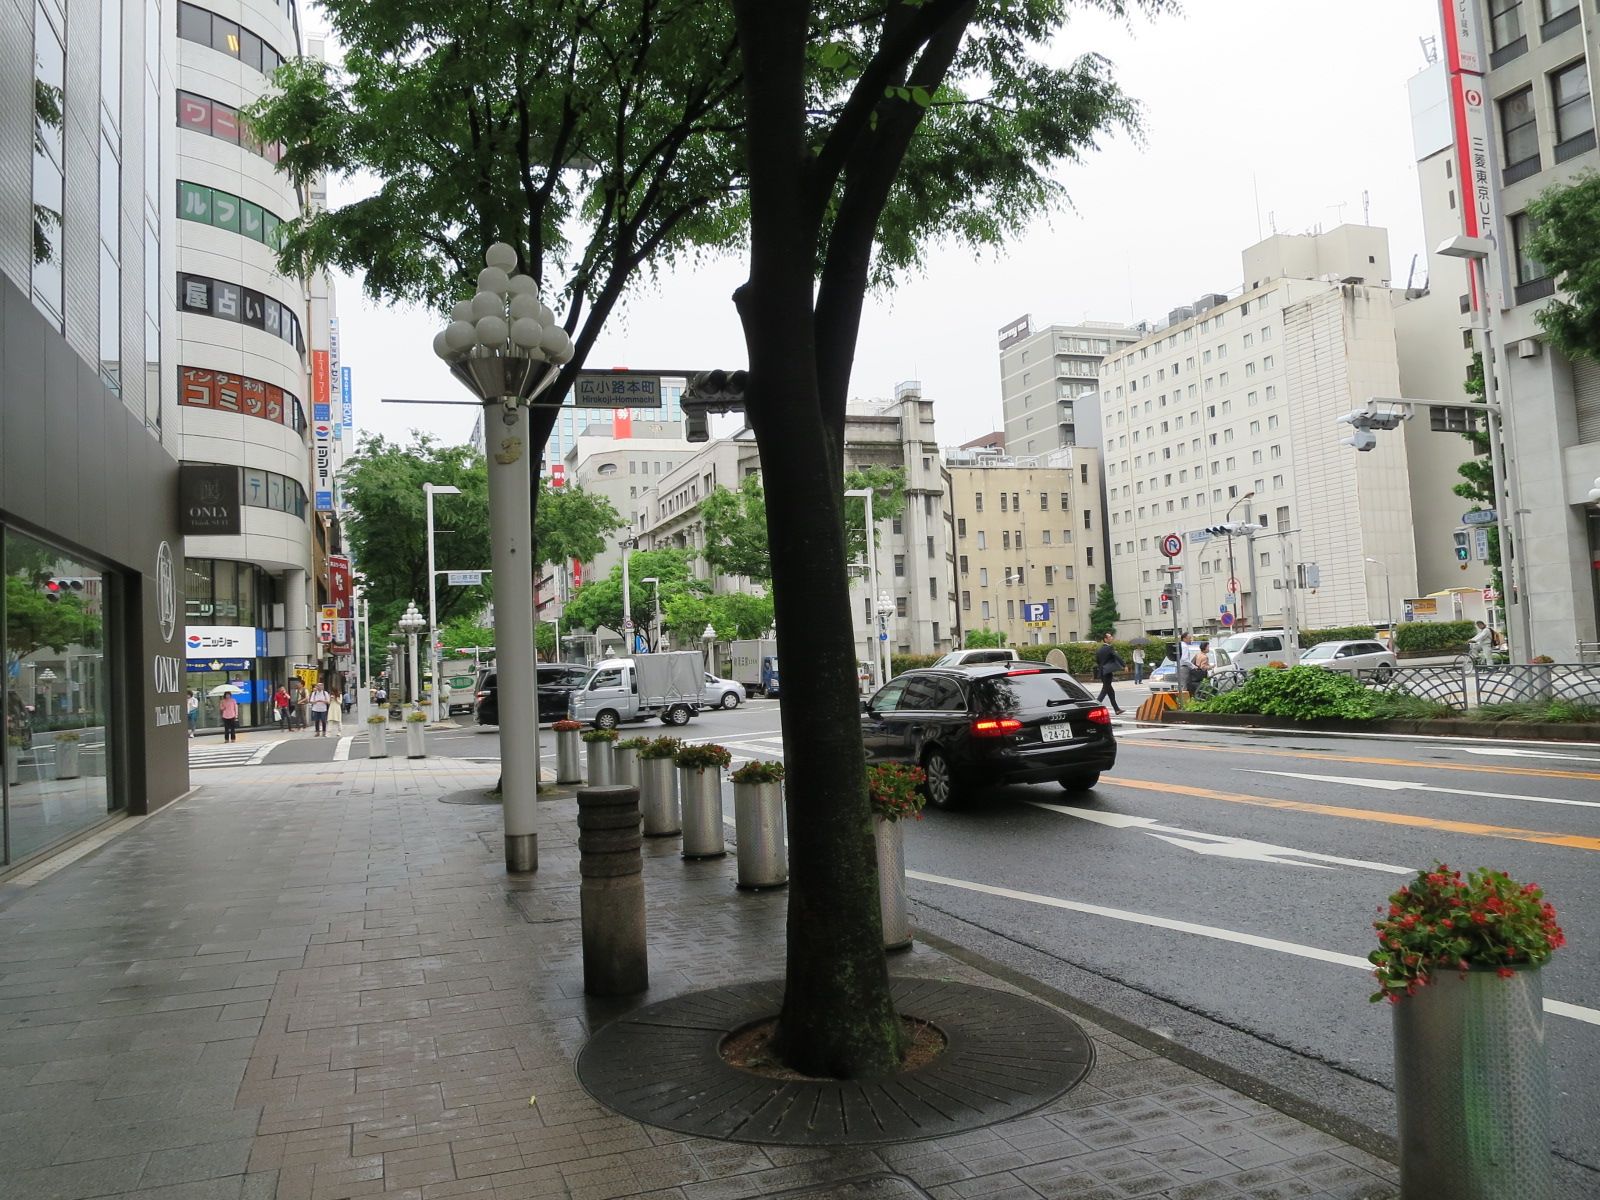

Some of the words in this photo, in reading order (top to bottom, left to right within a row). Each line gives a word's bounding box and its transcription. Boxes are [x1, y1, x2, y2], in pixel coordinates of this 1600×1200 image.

[184, 370, 264, 393] インターネット
[581, 380, 655, 394] 広小路本町
[187, 384, 281, 419] コミック
[189, 507, 228, 518] ONLY
[202, 637, 239, 647] ニッショー
[154, 655, 181, 693] ONLY
[1048, 729, 1071, 740] 24-22
